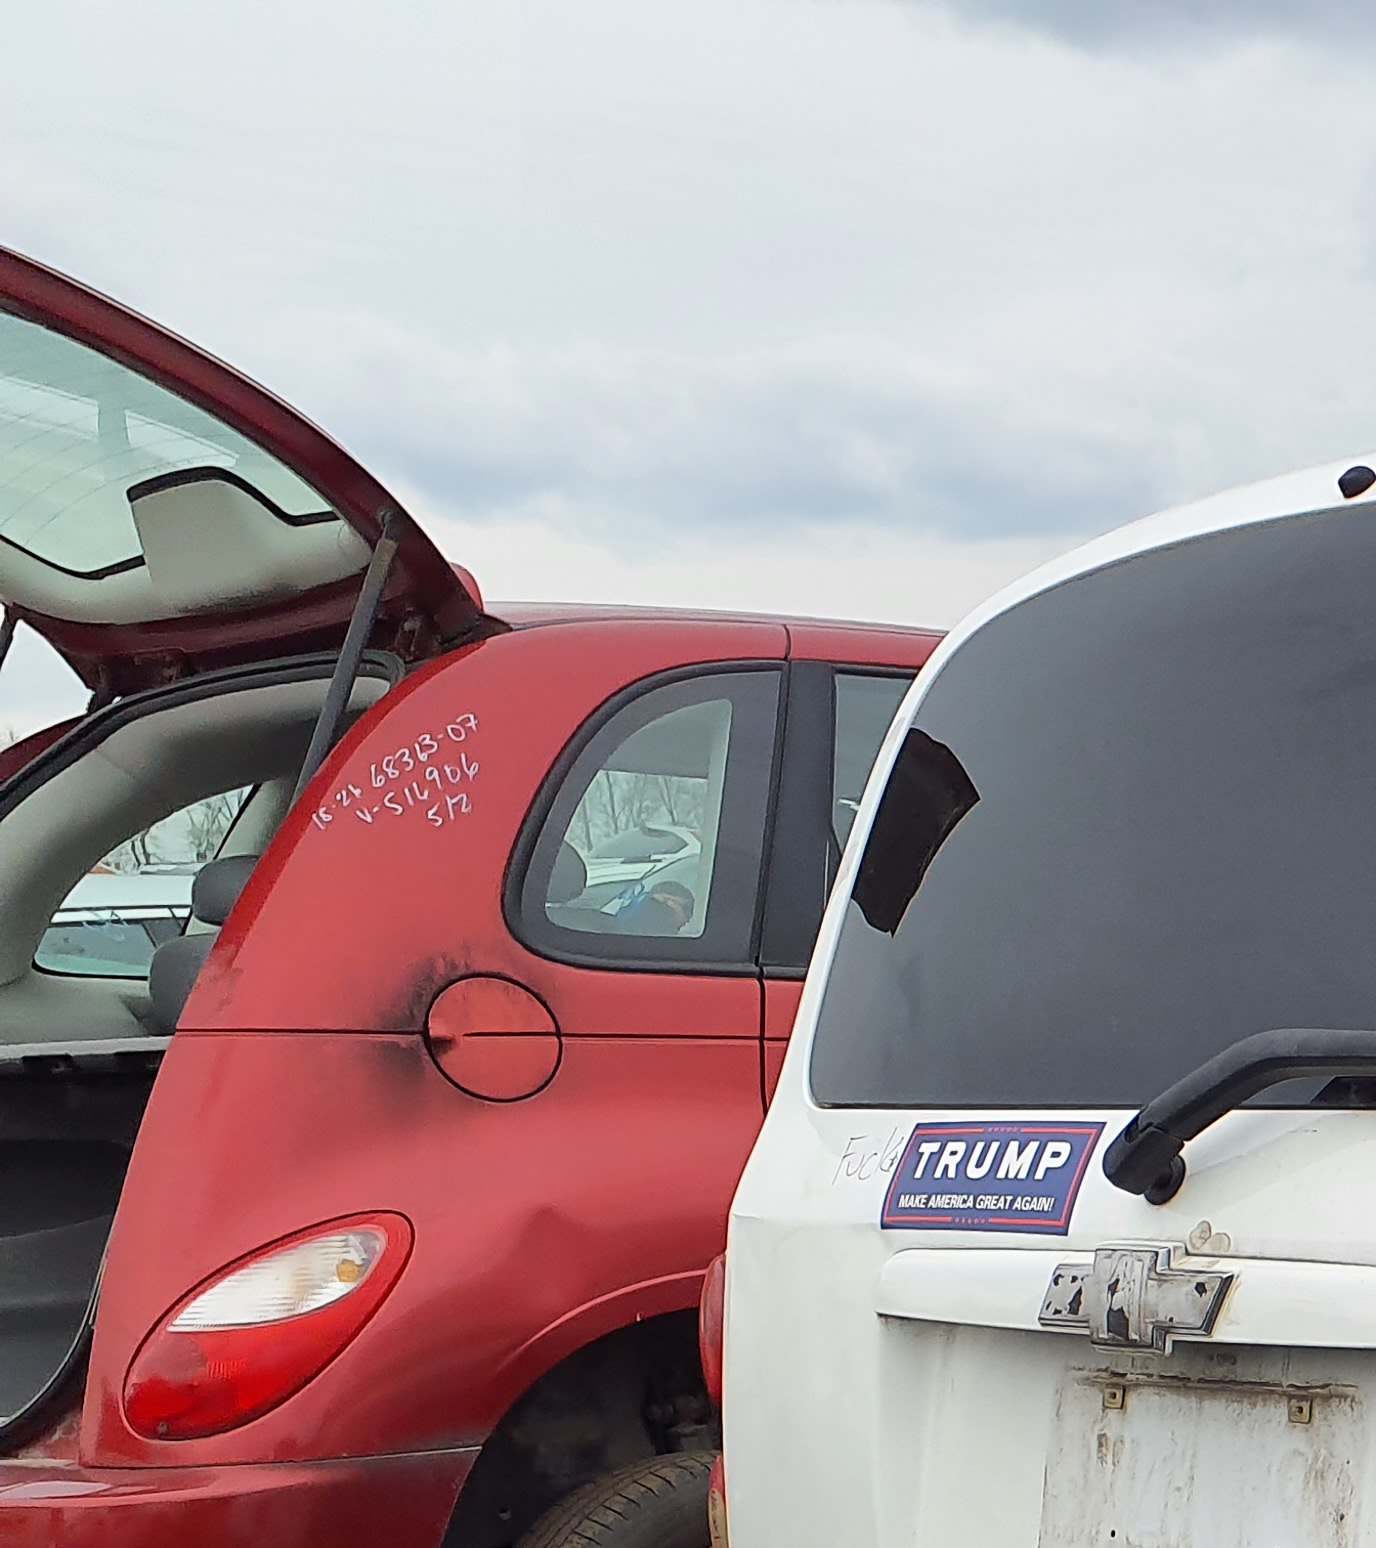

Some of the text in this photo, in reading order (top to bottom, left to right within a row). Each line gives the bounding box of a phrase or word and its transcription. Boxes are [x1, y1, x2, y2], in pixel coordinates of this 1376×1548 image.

[912, 1140, 1071, 1181] TRUMP
[898, 1194, 1055, 1212] MAKE AMERICA GREAT AGAIN!
